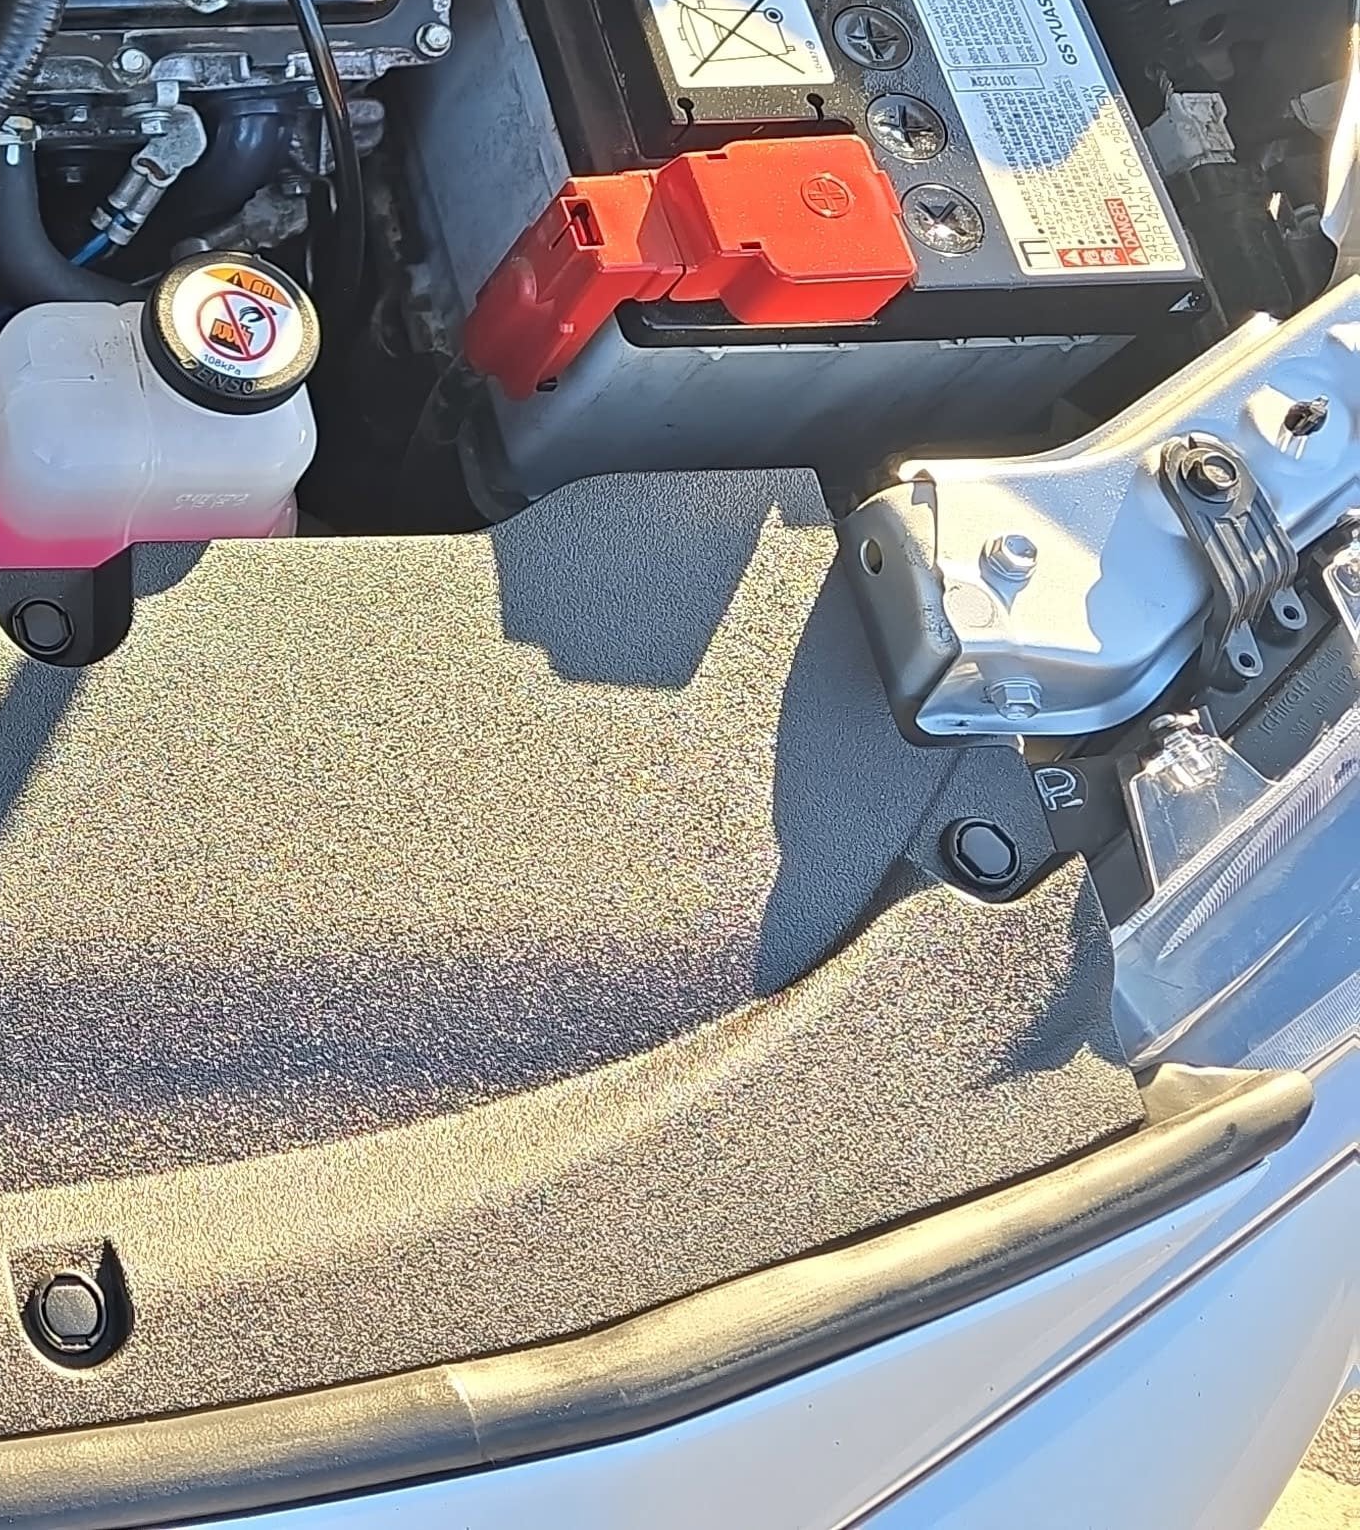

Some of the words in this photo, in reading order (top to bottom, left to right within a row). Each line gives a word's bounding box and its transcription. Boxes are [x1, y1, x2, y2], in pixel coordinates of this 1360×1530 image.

[933, 15, 950, 37] TOYOTA
[939, 6, 954, 23] TEXAS
[962, 14, 979, 35] TOYOTA
[981, 13, 999, 35] TOYOTA
[1080, 86, 1094, 102] 12V
[1088, 84, 1129, 143] 295A(EN)
[1115, 145, 1144, 177] CCA
[1114, 171, 1164, 262] 345LN1-MF
[1132, 185, 1163, 220] 45Ah
[1105, 199, 1141, 247] DANGER
[1150, 224, 1182, 262] 20HR
[180, 356, 257, 394] DENSO
[203, 354, 242, 376] 108kPa
